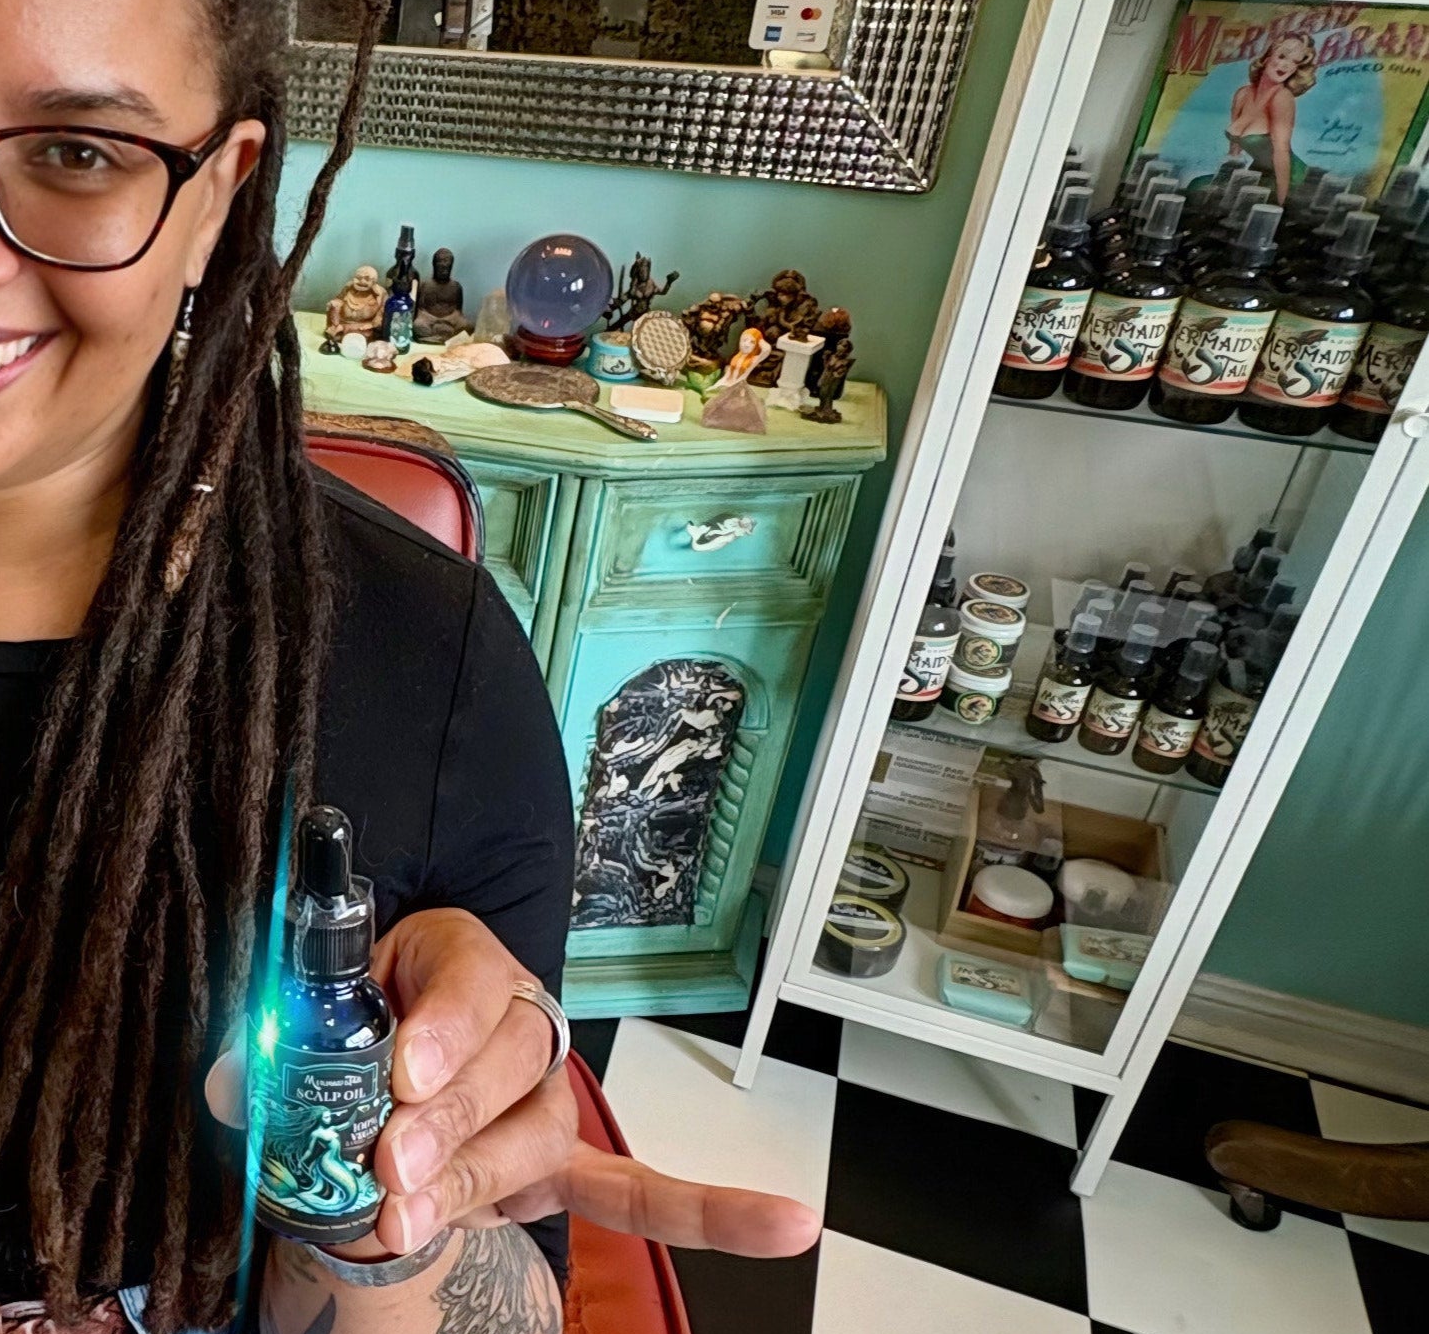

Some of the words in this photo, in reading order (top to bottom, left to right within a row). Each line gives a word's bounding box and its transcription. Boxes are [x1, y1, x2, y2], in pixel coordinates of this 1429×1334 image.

[1014, 311, 1081, 331] ERMAID
[1214, 354, 1247, 381] TAIL
[296, 1088, 341, 1102] SCALP
[343, 1087, 366, 1101] OIL
